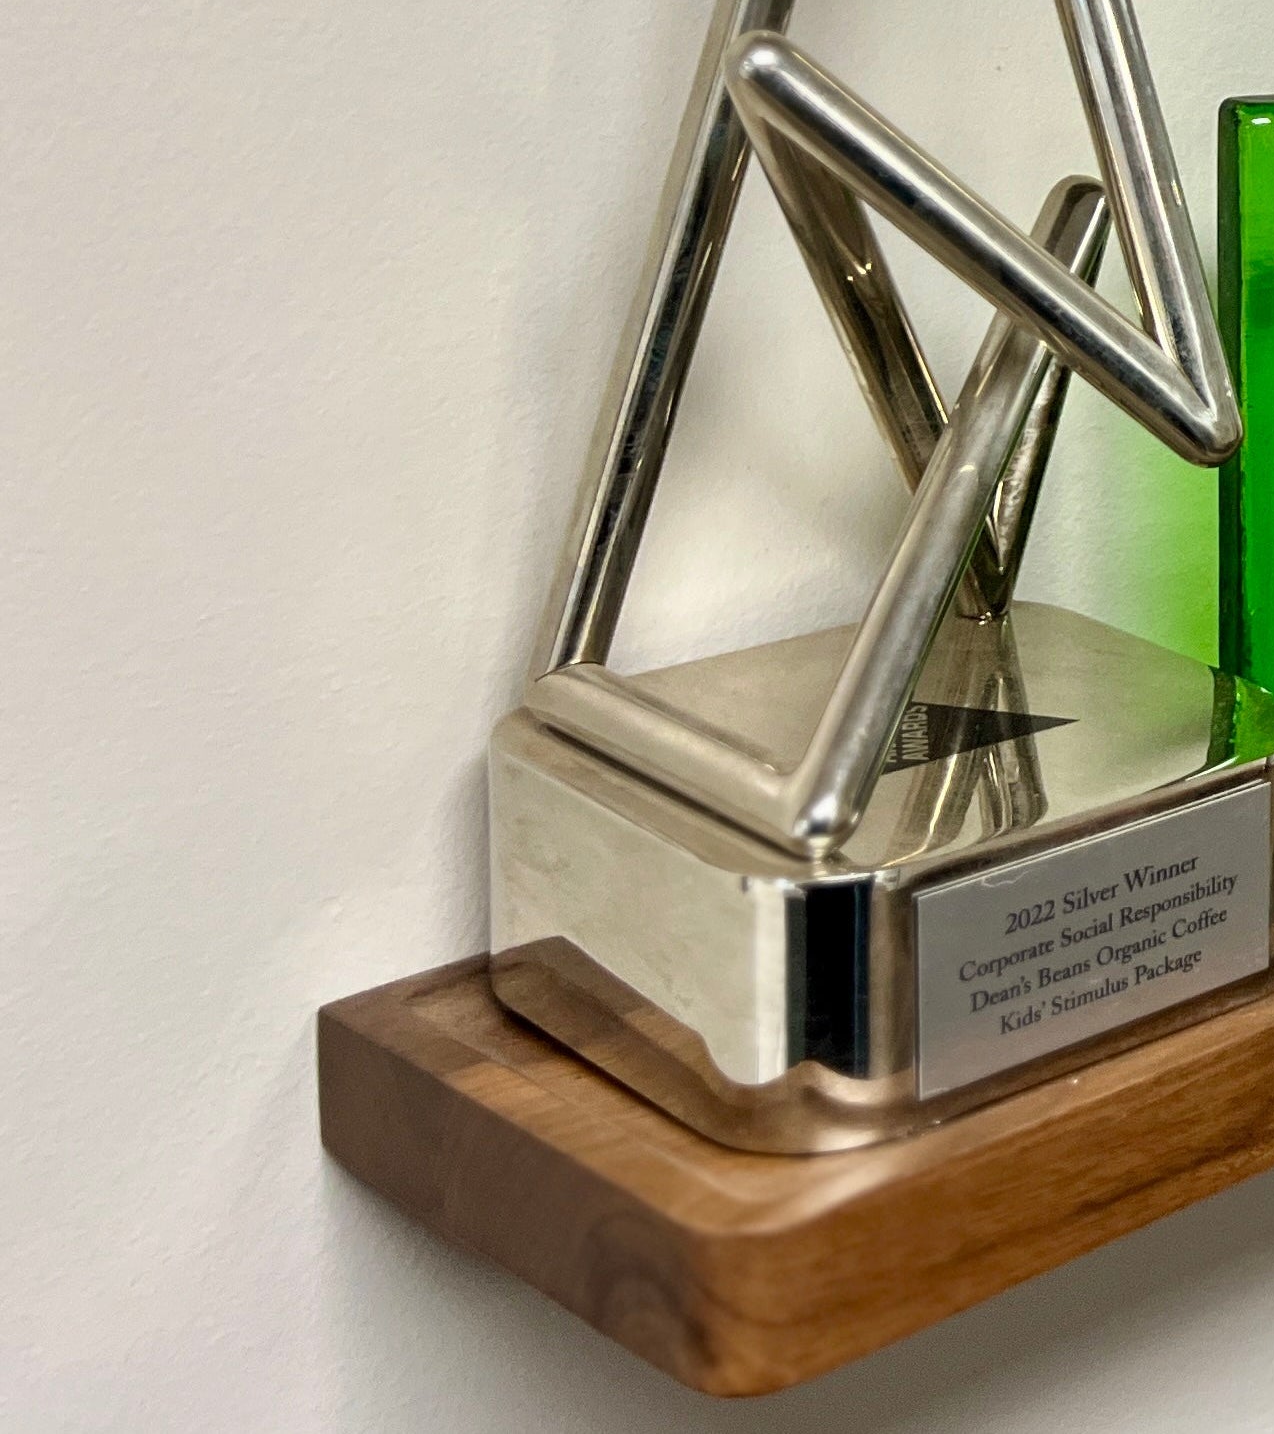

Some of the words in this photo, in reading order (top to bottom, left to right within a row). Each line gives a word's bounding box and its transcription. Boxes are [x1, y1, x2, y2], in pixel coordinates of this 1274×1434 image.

[902, 703, 930, 762] AWARDS
[959, 938, 1055, 984] Corporate
[1060, 916, 1114, 949] Social
[1120, 872, 1239, 929] Responsibility
[1005, 899, 1055, 935] 2022
[1062, 883, 1120, 915] Silver
[1123, 855, 1200, 893] Winner
[970, 976, 1032, 1014] Dean's
[1038, 958, 1091, 990] Beans
[1096, 927, 1168, 969] Organic
[1172, 906, 1228, 940] Coffee
[1000, 1000, 1047, 1036] Kids'
[1051, 977, 1130, 1016] Stimulus
[1134, 947, 1203, 987] Package
